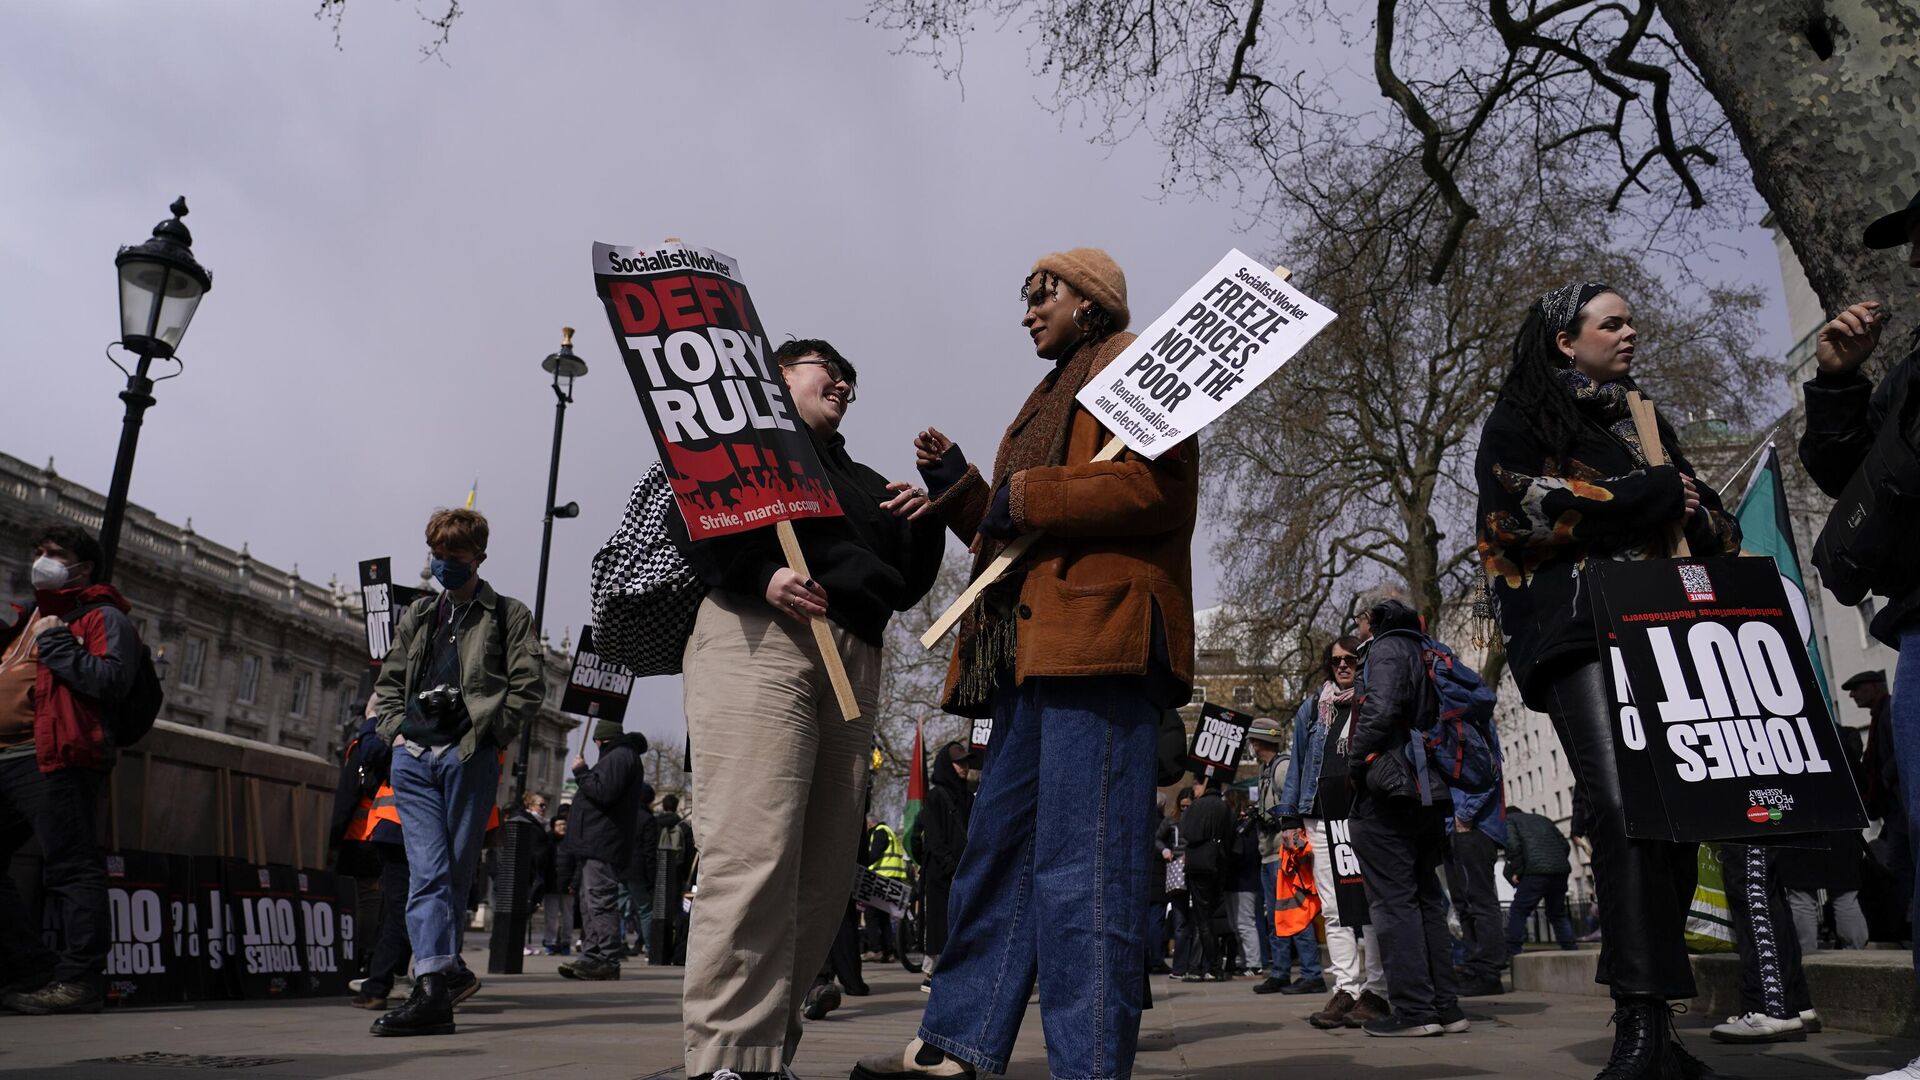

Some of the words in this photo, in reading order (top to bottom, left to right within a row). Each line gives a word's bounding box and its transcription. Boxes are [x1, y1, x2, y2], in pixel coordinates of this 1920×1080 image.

[607, 275, 751, 334] DEFY
[1203, 277, 1290, 345] FREEZE
[625, 327, 773, 388] TORY
[1176, 301, 1260, 374] PRICES,
[1125, 352, 1192, 413] POOR
[1150, 327, 1207, 373] NOT
[1193, 358, 1244, 402] THE
[649, 379, 797, 443] RULE
[1095, 395, 1119, 414] and
[1112, 410, 1157, 448] electricity
[1109, 378, 1170, 433] Renationalise
[699, 512, 744, 530] Strike,
[743, 499, 788, 522] march
[788, 500, 821, 513] occupy
[1622, 609, 1697, 622] #NotFitToGovern
[1690, 593, 1714, 601] DONATE
[367, 611, 391, 659] OUT
[571, 666, 632, 695] GOVERN
[1646, 621, 1804, 723] OUT
[1195, 731, 1241, 766] OUT
[1203, 716, 1245, 742] TORIES
[1666, 716, 1832, 782] TORIES
[1749, 788, 1783, 797] ASSEMBLY
[242, 897, 297, 946] OUT
[244, 945, 302, 975] TORIES
